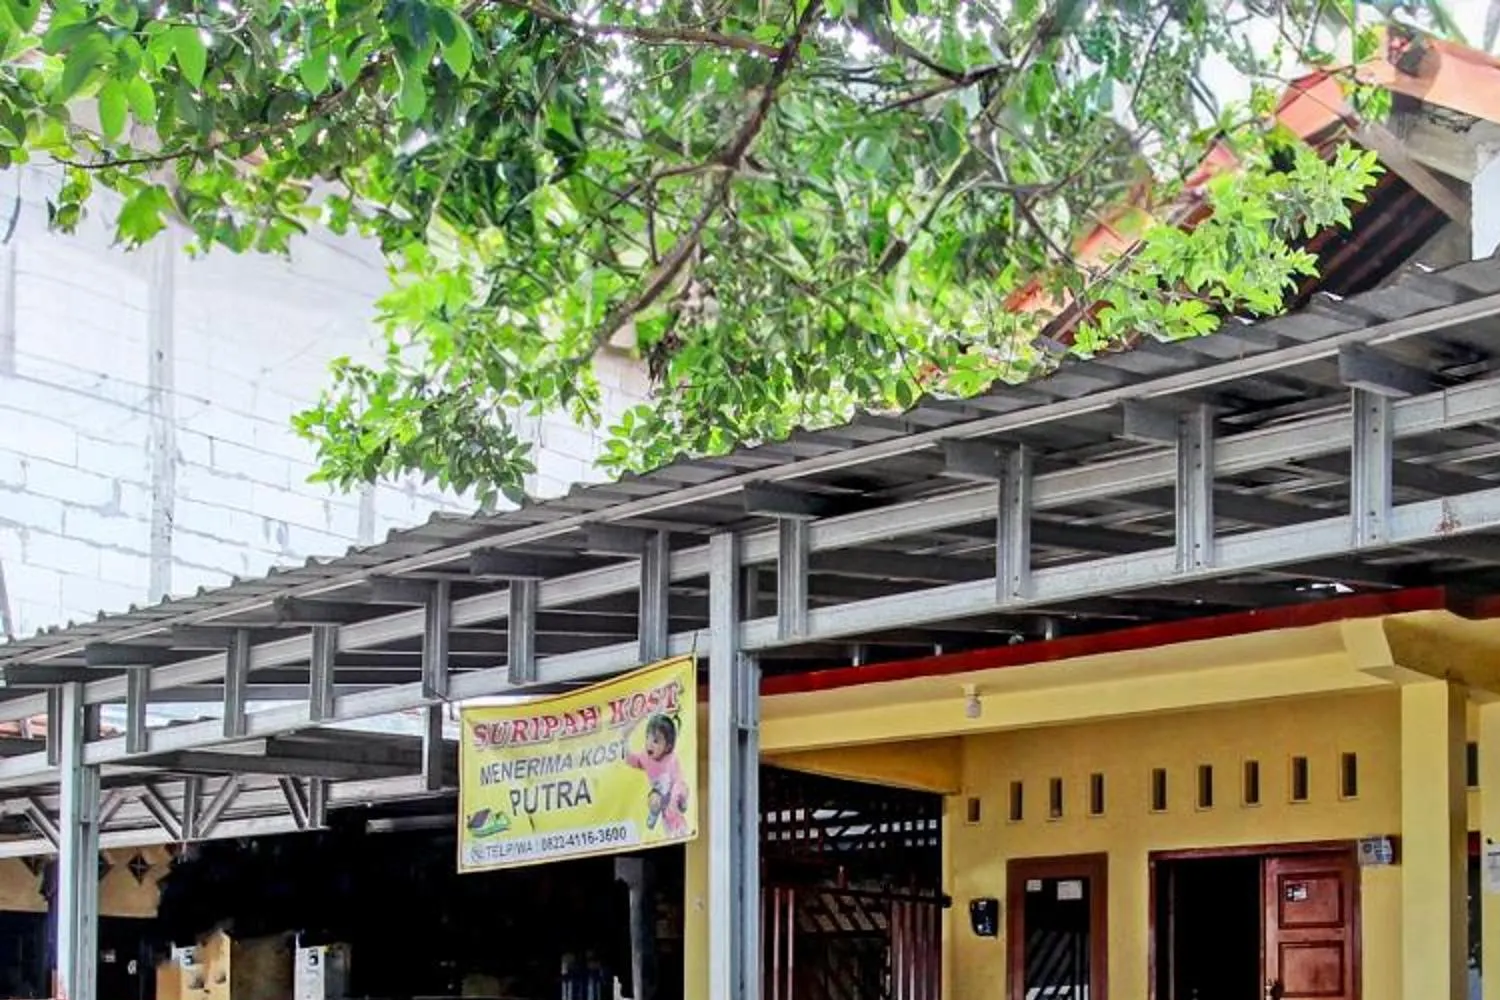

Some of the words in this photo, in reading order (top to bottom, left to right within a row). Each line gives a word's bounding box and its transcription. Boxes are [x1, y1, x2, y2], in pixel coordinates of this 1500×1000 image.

[473, 705, 599, 746] SURIPAH
[608, 682, 680, 725] KOST
[480, 752, 573, 786] MENERIMA
[579, 740, 627, 769] KOST
[509, 776, 592, 816] PUTRA
